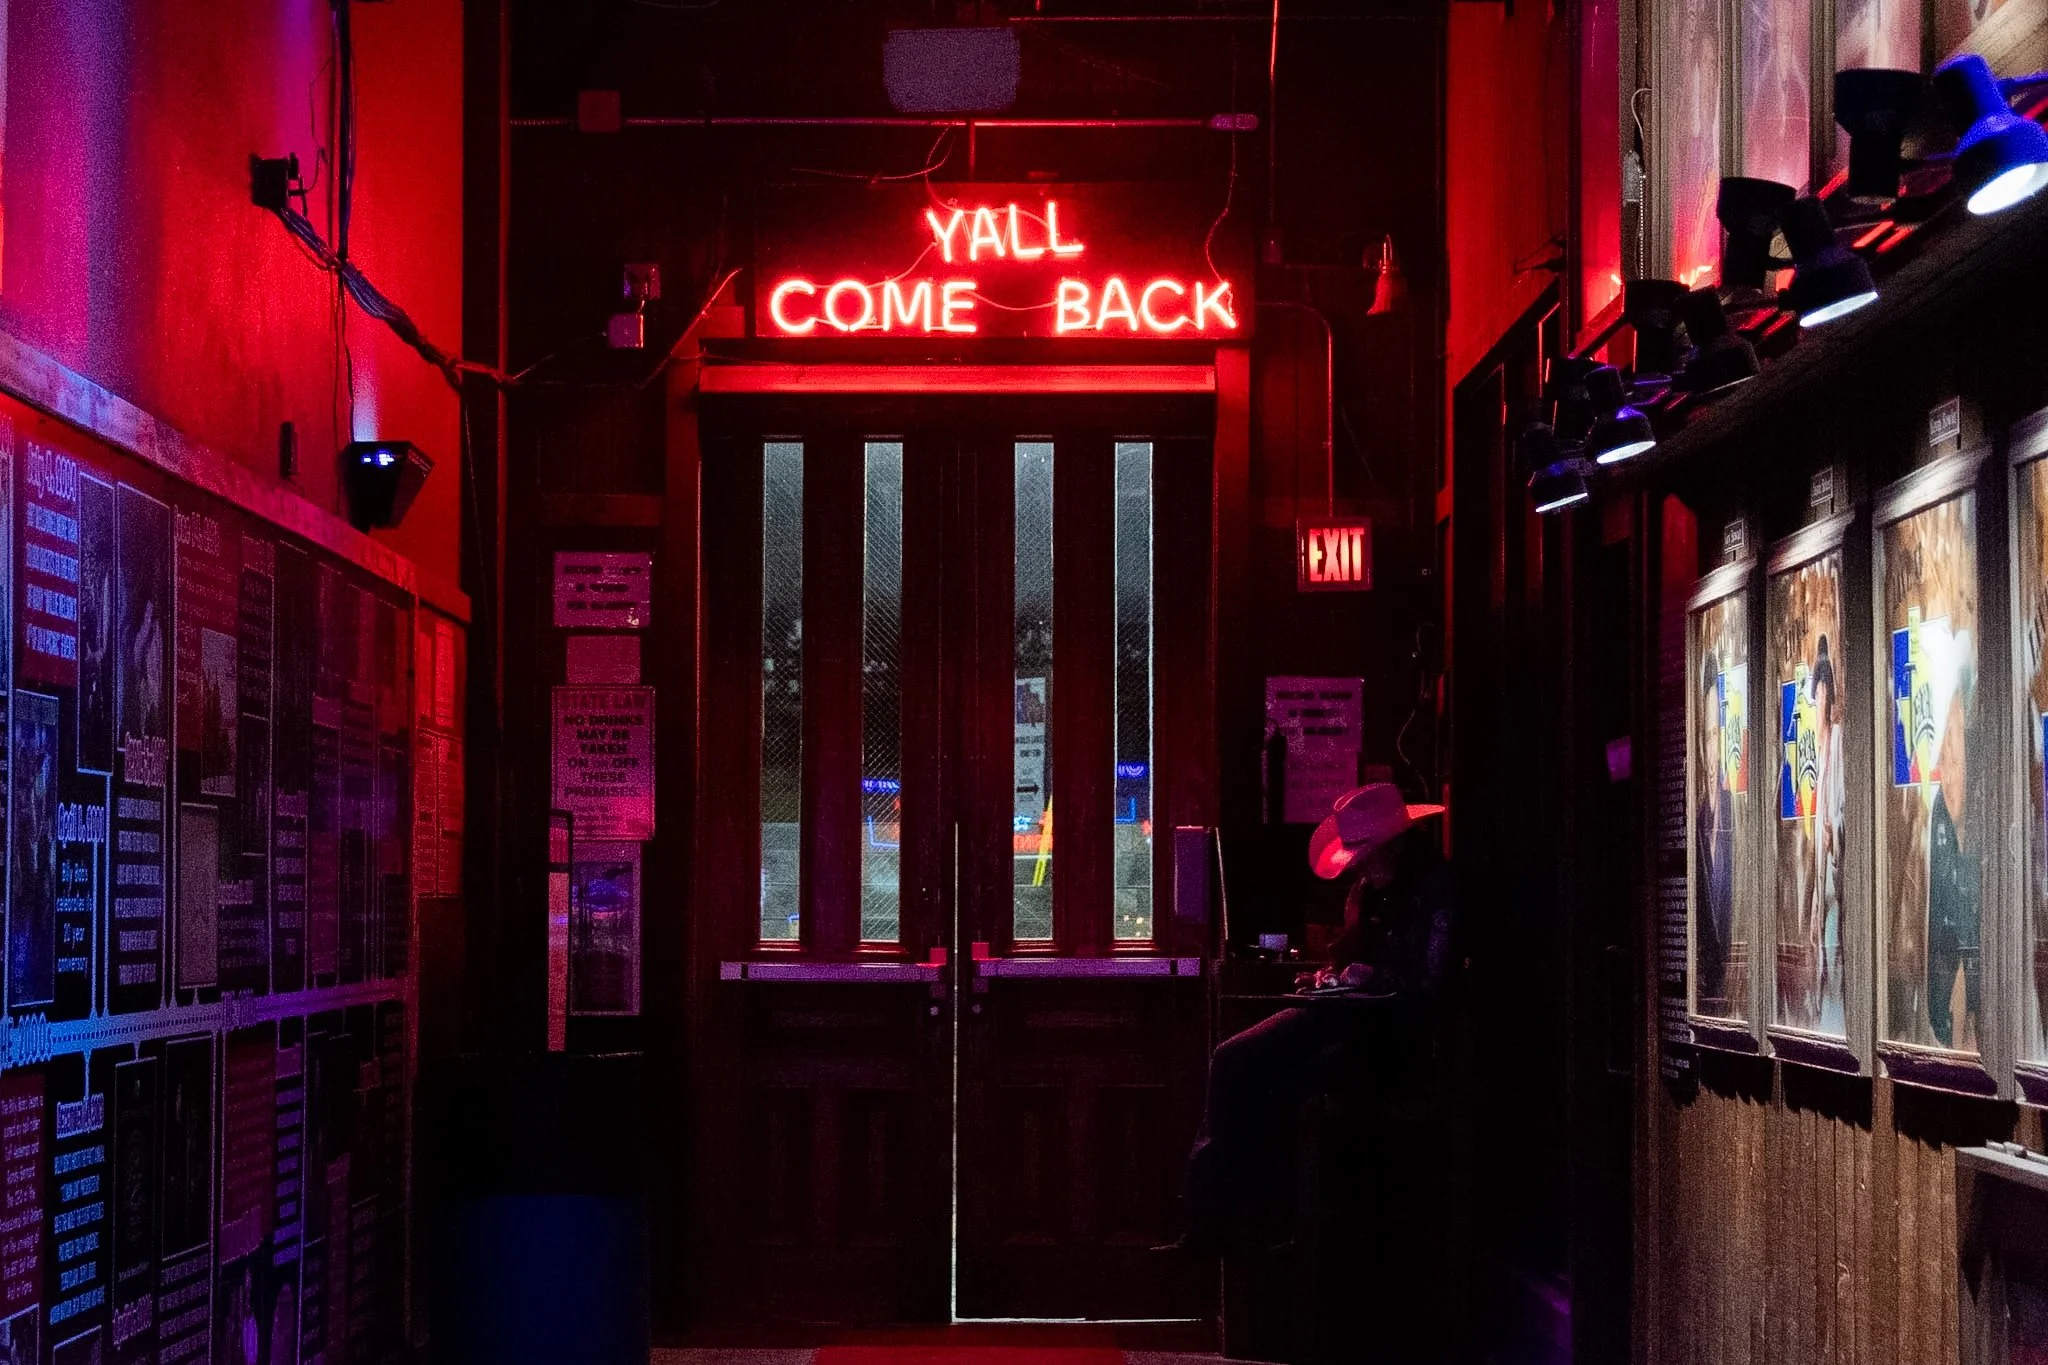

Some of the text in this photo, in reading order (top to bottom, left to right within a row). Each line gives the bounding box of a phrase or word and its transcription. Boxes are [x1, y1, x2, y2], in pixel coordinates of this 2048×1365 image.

[926, 201, 1085, 262] YALL
[770, 277, 1237, 333] COME BACK
[1308, 527, 1365, 583] EXIT
[577, 728, 629, 740] MAY BE
[582, 743, 627, 754] TAKEN
[568, 757, 588, 768] ON
[614, 757, 639, 768] OFF
[582, 771, 625, 783] THESE
